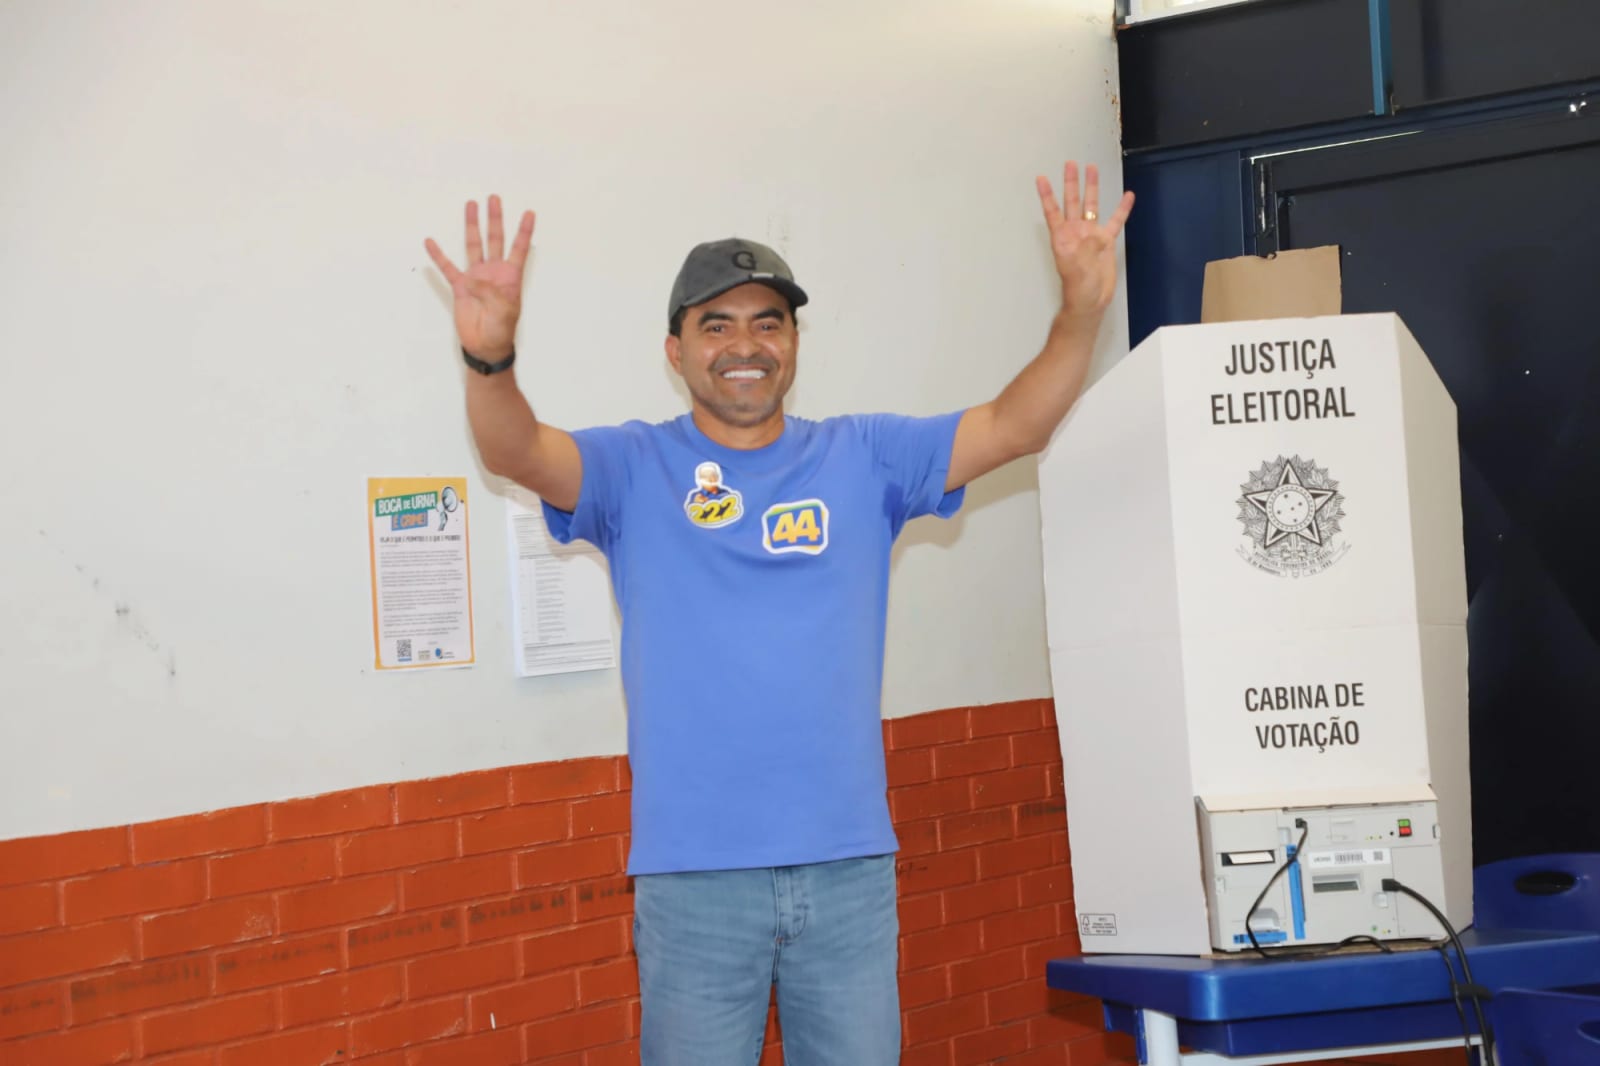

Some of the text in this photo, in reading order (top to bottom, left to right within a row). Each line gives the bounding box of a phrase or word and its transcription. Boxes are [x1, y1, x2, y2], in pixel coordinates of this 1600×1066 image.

[1225, 338, 1336, 379] JUSTIÇA
[1211, 386, 1356, 425] ELEITORAL
[378, 498, 402, 514] BOCA
[412, 494, 436, 509] URNA
[772, 508, 821, 543] 44
[1244, 682, 1365, 713] CABINA DE
[1255, 716, 1360, 754] VOTAÇÃO
